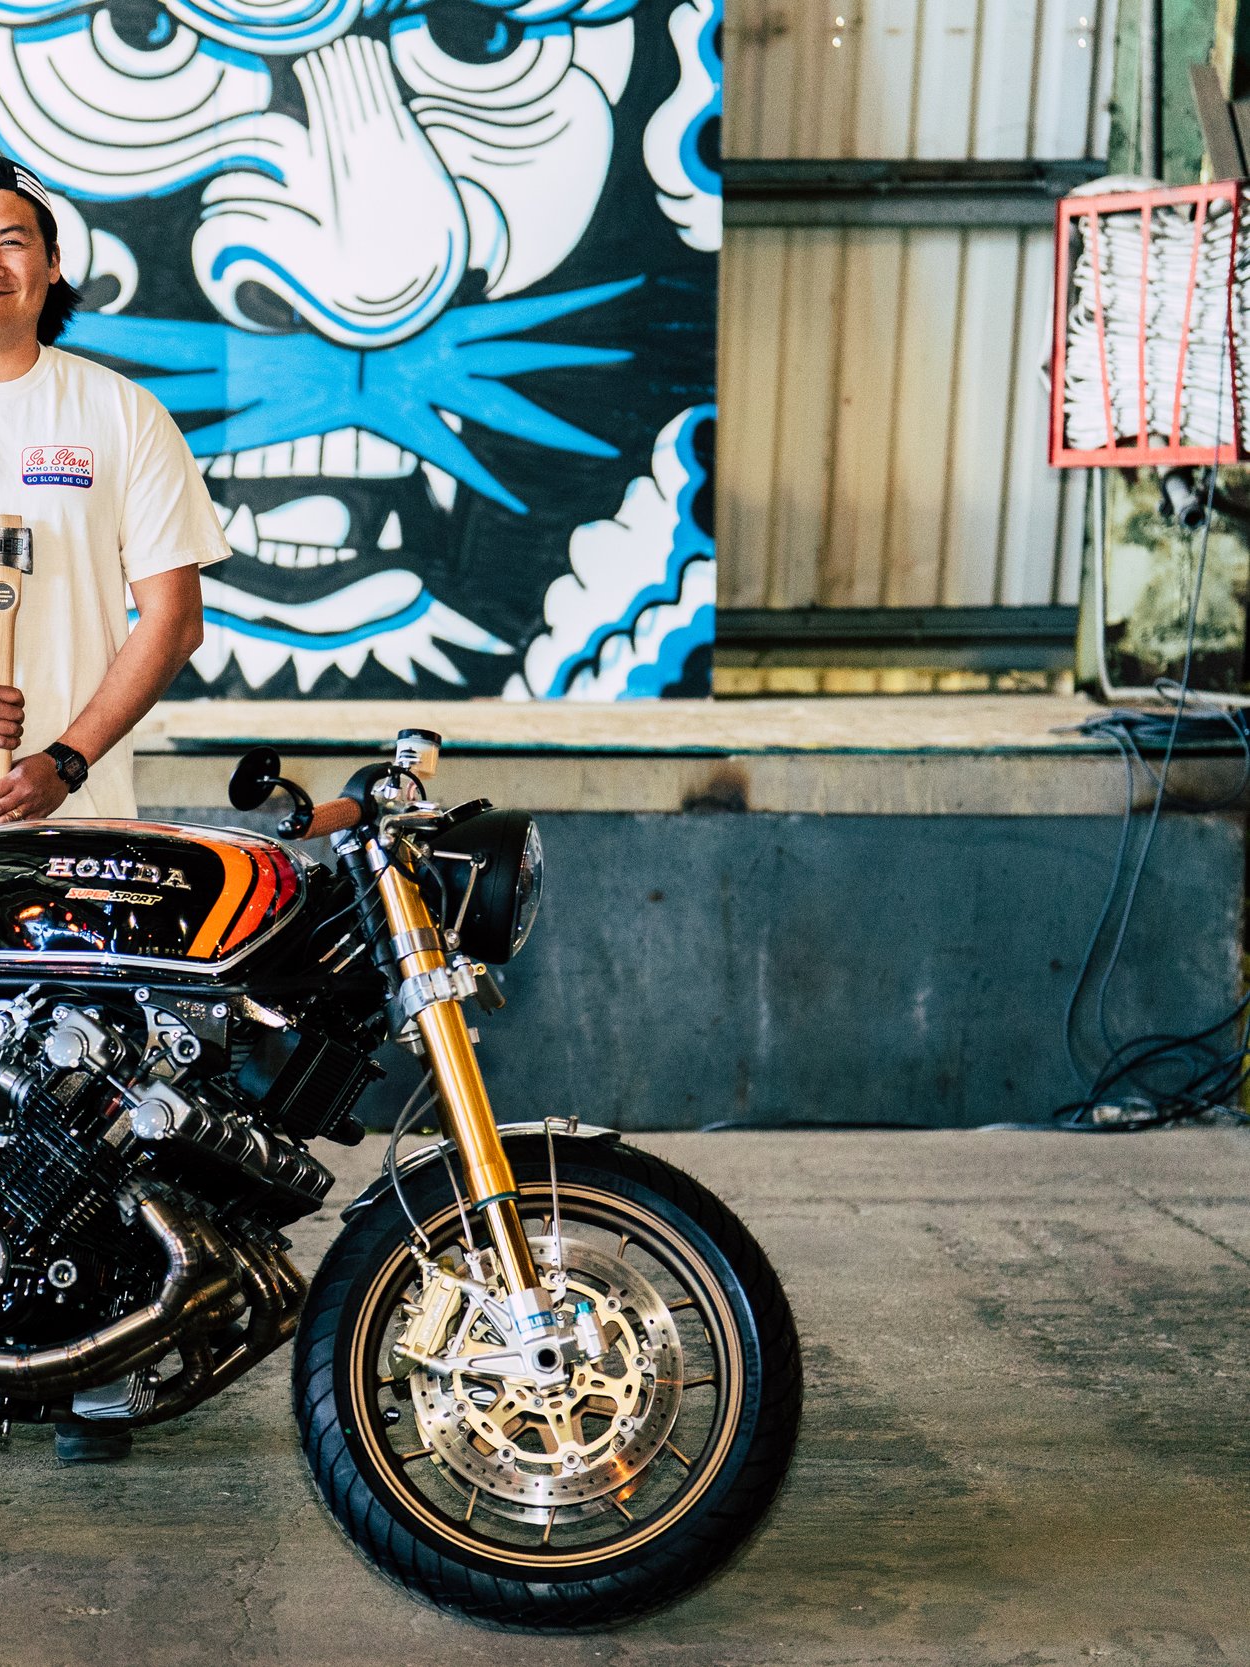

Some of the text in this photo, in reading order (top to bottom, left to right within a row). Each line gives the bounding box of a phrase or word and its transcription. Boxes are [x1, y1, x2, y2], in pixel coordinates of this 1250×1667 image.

[25, 448, 90, 467] So Slow
[75, 478, 89, 486] OLD
[46, 857, 191, 890] HONDA
[741, 1337, 759, 1437] MUTANT
